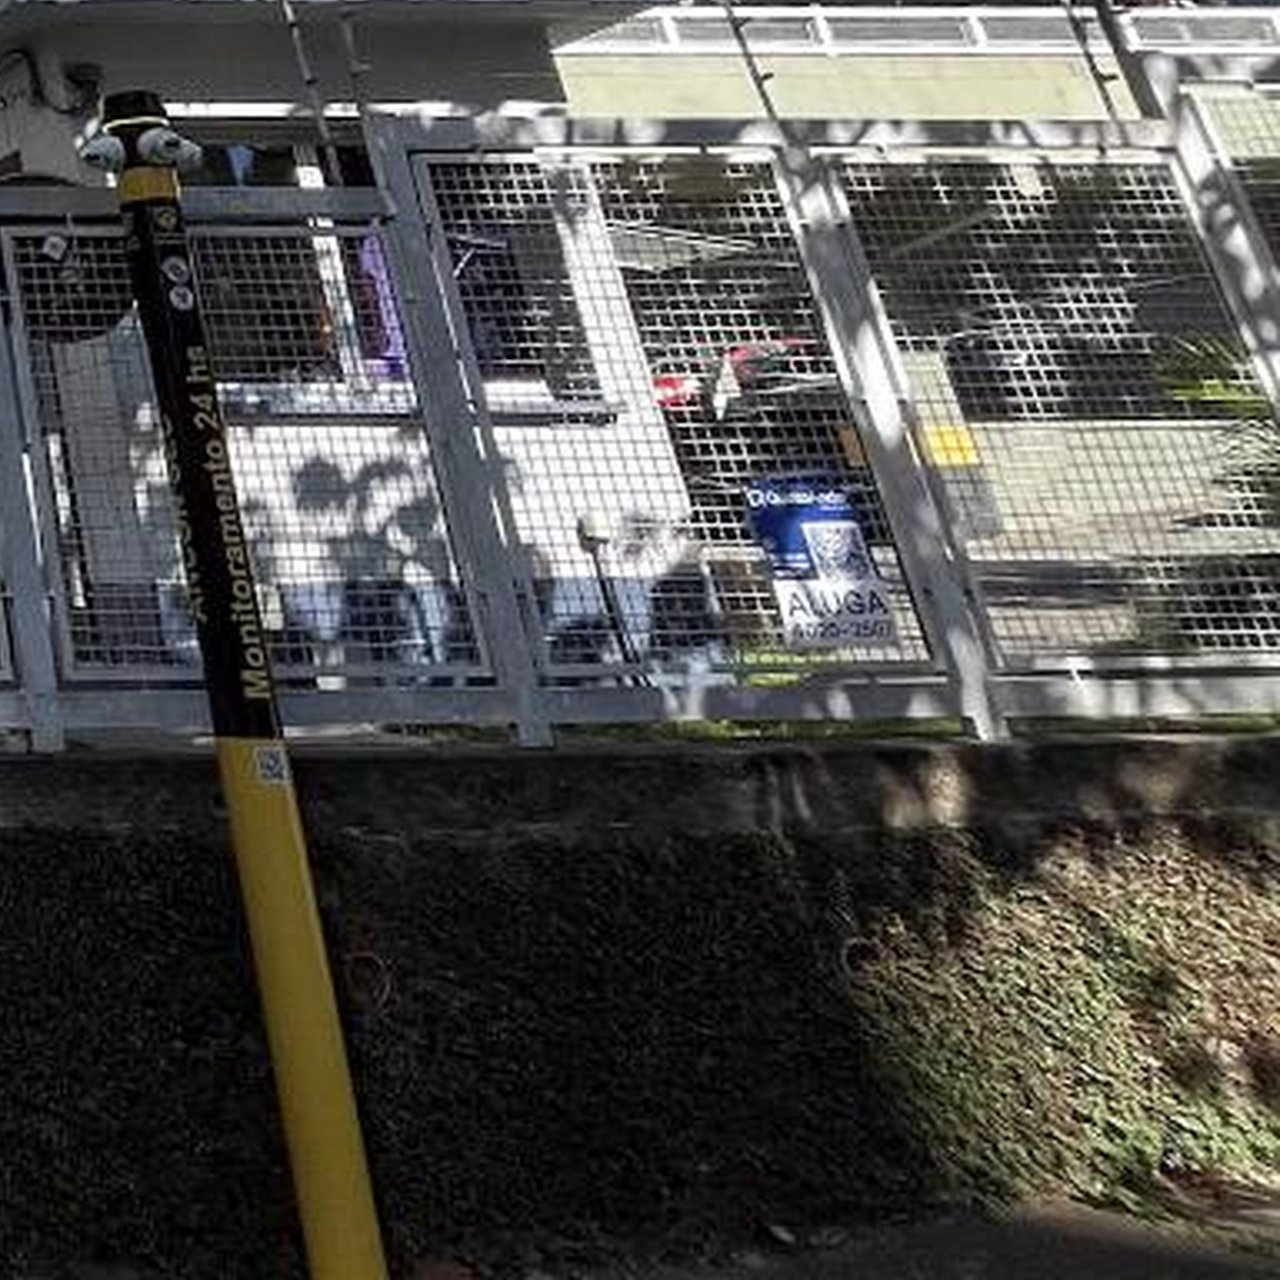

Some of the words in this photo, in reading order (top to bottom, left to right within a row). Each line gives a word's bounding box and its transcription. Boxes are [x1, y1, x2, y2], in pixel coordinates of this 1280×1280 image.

[189, 394, 220, 431] 24
[202, 440, 271, 699] Monitoramento
[789, 589, 888, 617] ALUGA
